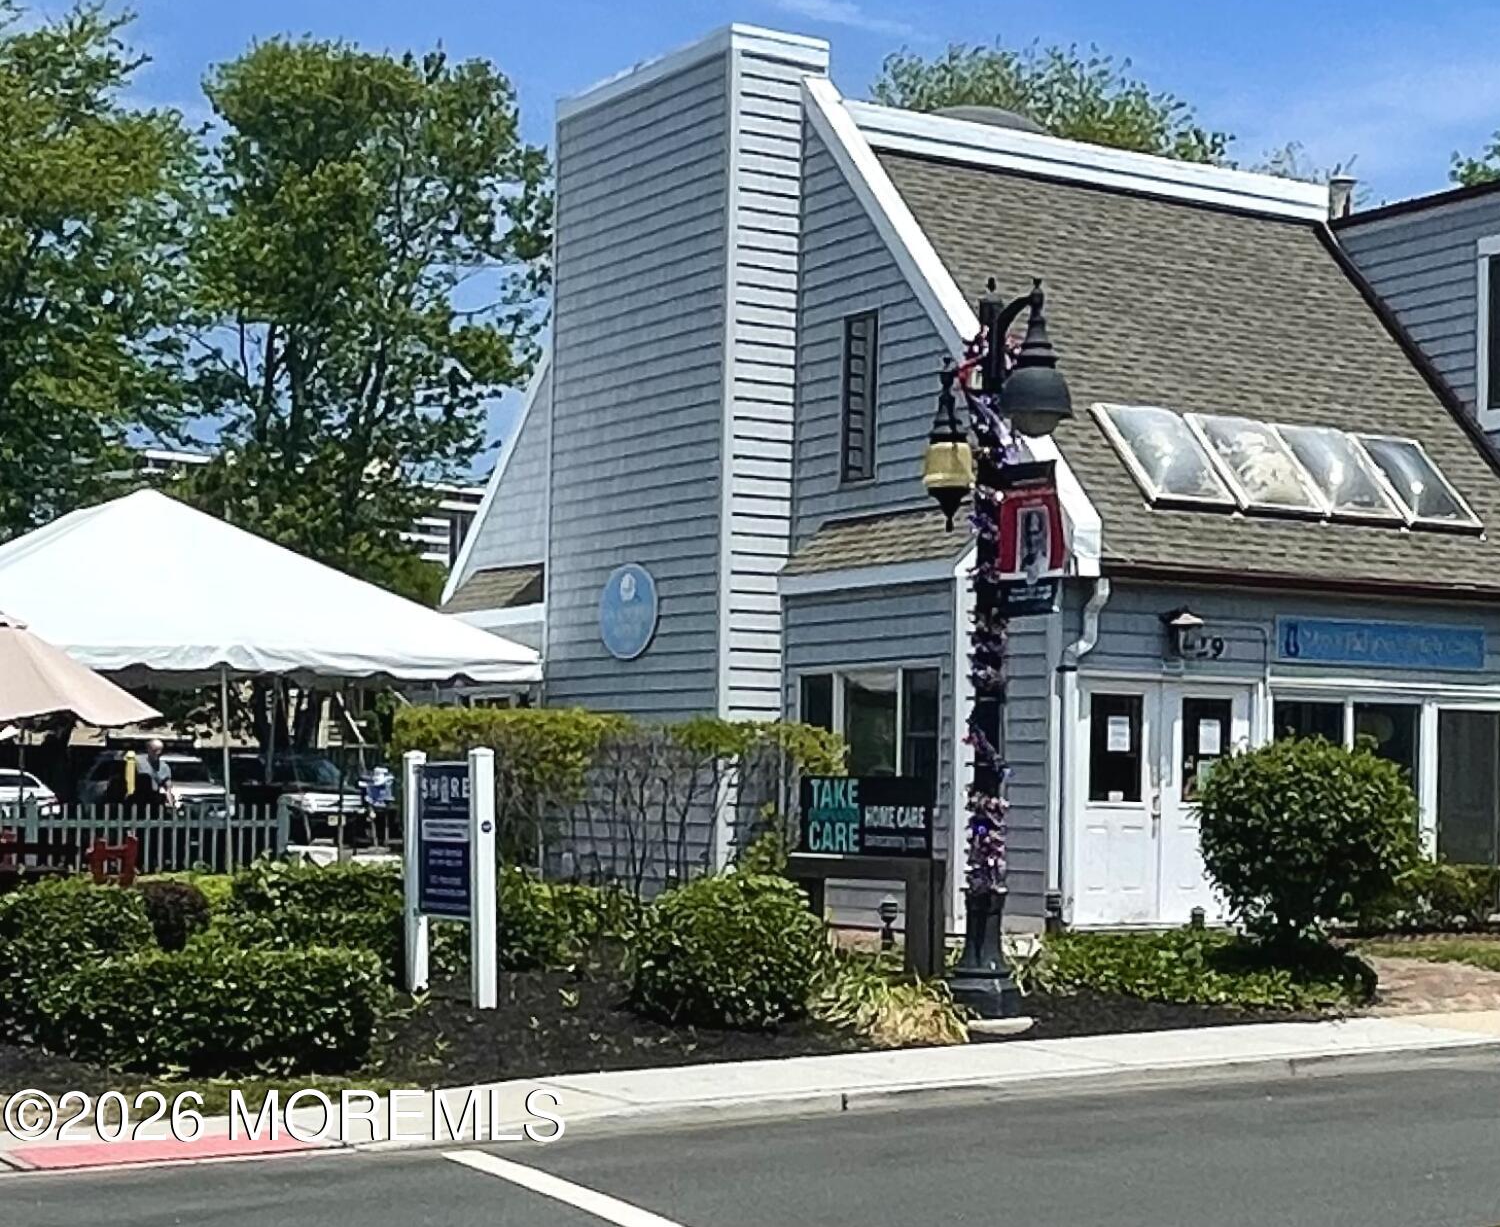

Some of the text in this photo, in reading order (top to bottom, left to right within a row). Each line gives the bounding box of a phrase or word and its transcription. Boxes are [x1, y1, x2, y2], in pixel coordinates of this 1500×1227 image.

[811, 779, 859, 809] TAKE
[865, 806, 896, 828] HOME
[897, 806, 926, 828] CARE
[809, 822, 859, 852] CARE
